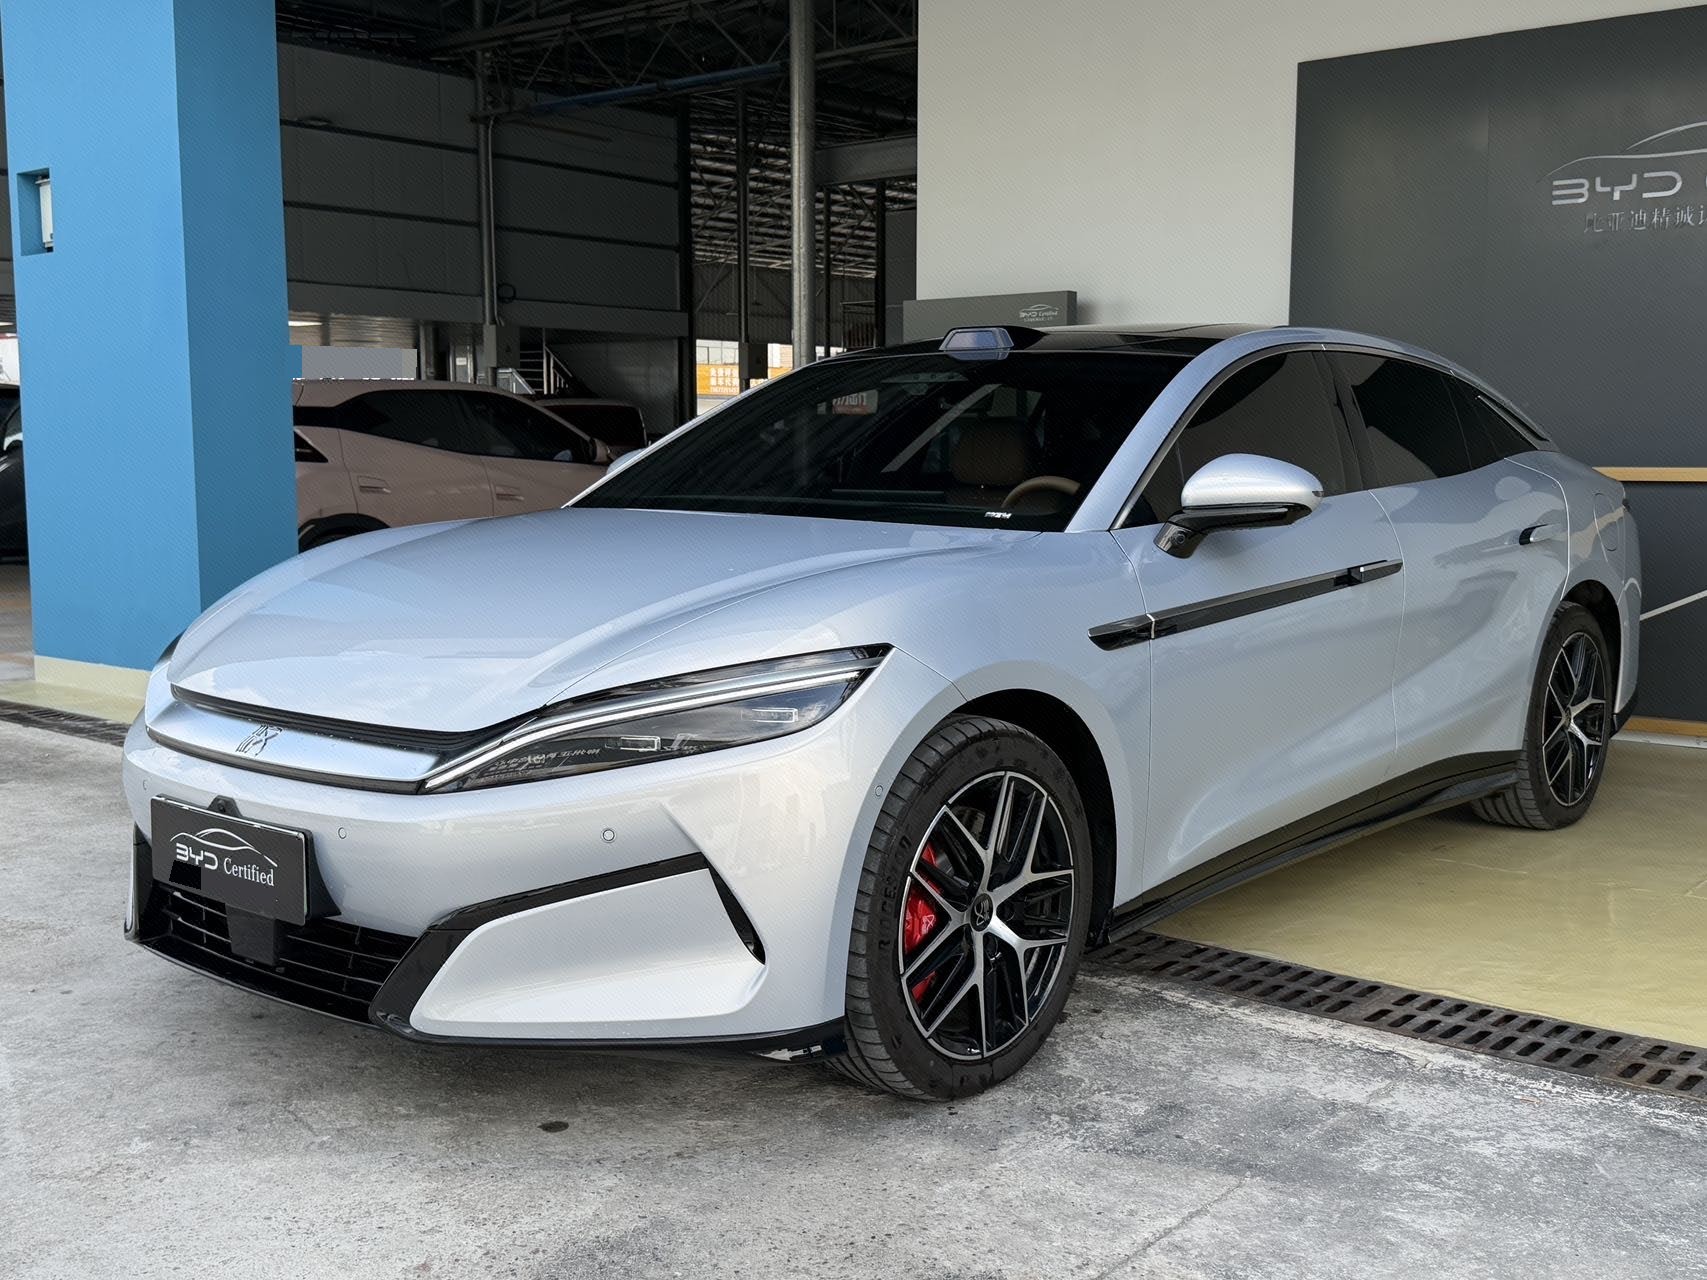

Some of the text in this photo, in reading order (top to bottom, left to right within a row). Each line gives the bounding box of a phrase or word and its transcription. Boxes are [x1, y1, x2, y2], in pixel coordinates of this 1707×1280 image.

[1551, 170, 1683, 206] BYD
[175, 842, 275, 887] BYD Certified
